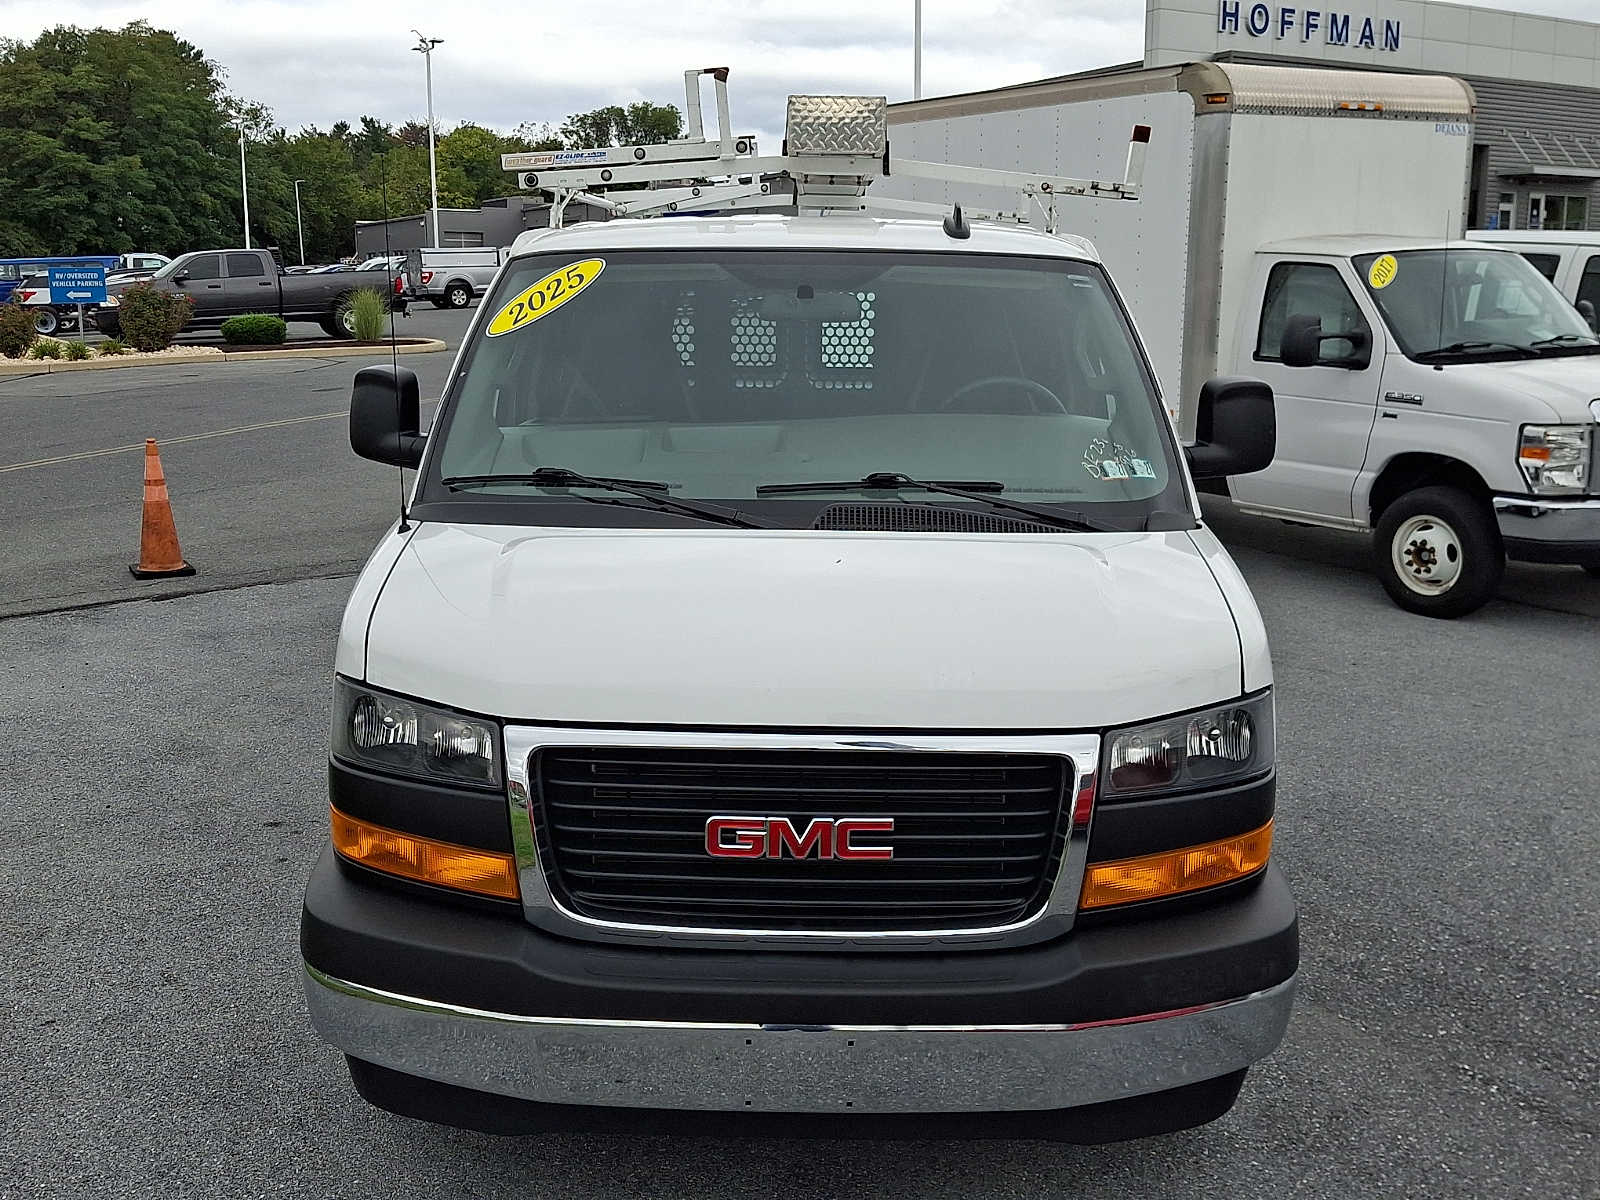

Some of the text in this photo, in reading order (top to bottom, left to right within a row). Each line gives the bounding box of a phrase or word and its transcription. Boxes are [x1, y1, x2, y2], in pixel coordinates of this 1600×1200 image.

[1220, 0, 1401, 49] HOFFMAN
[55, 272, 99, 280] RV/OVERSIZED
[1373, 258, 1393, 284] 2017
[508, 266, 585, 326] 2025
[705, 815, 895, 860] GMC
